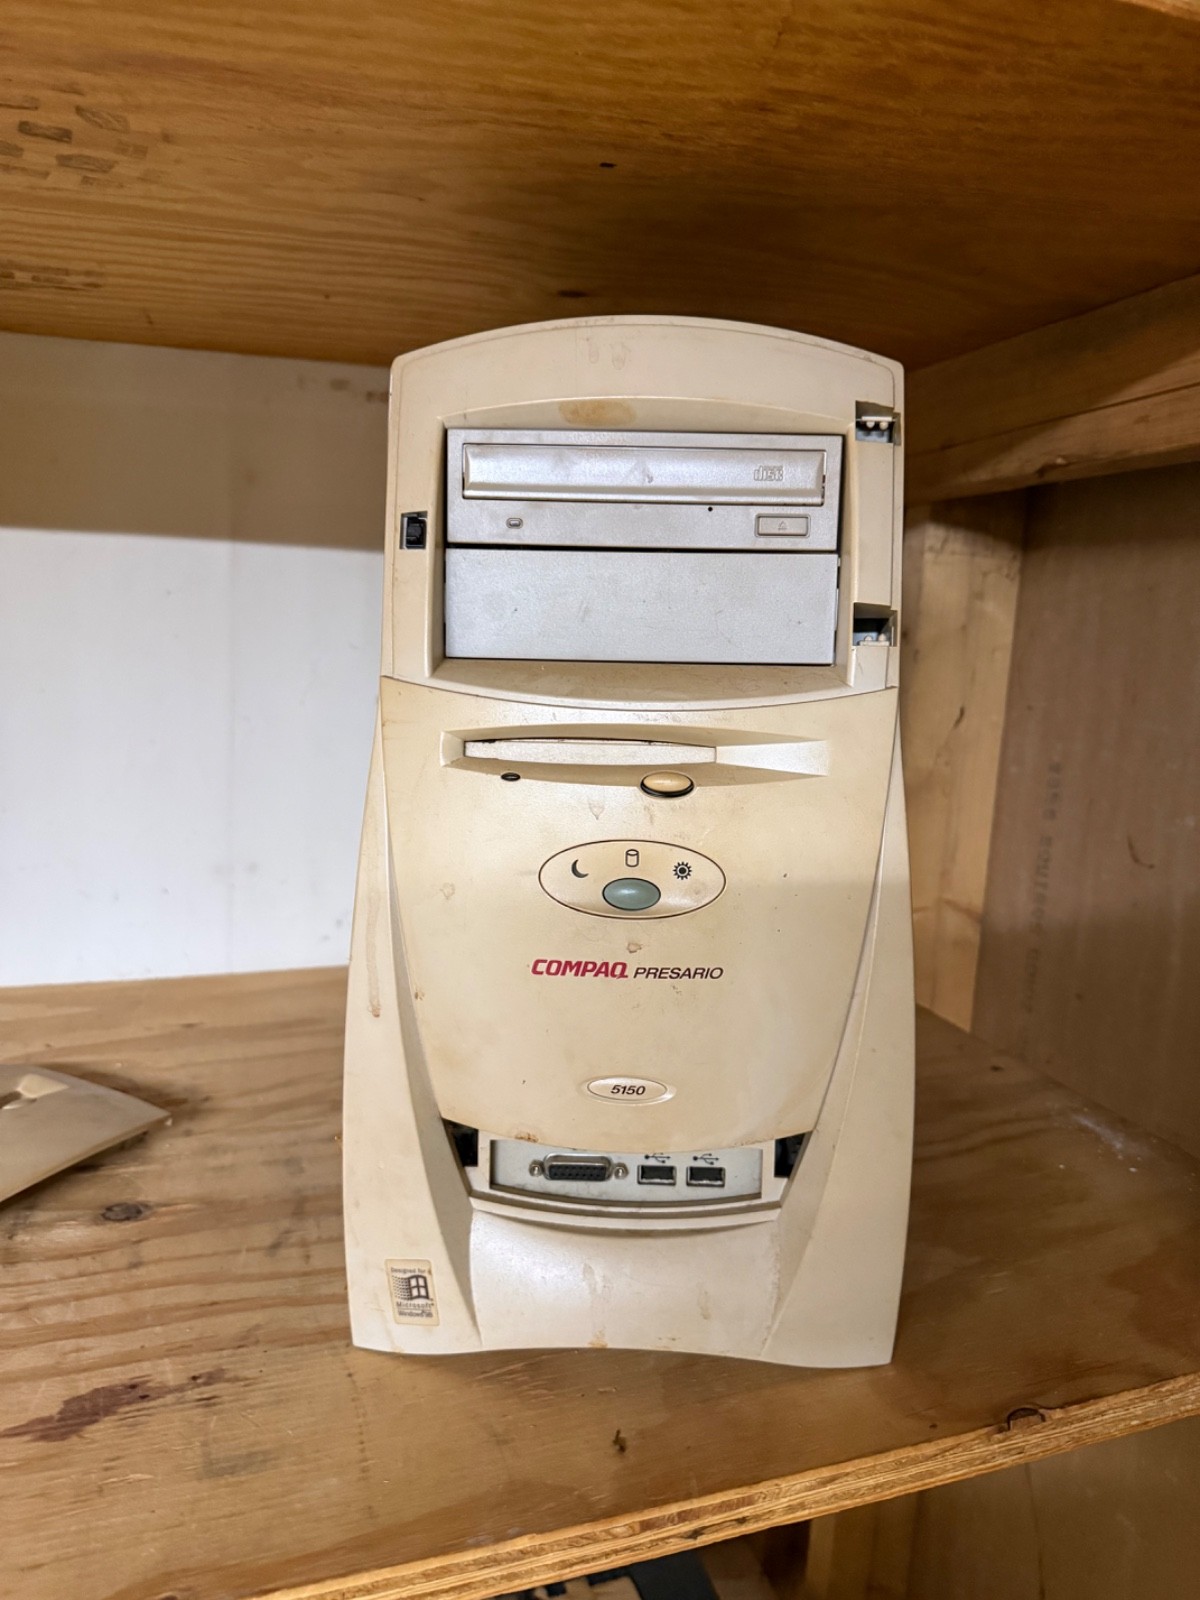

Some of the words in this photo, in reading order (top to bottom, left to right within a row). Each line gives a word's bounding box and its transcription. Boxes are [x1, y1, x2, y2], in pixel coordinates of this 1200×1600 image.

[531, 959, 629, 979] COMPAQ
[633, 967, 724, 980] PRESARIO
[610, 1084, 646, 1096] 5150
